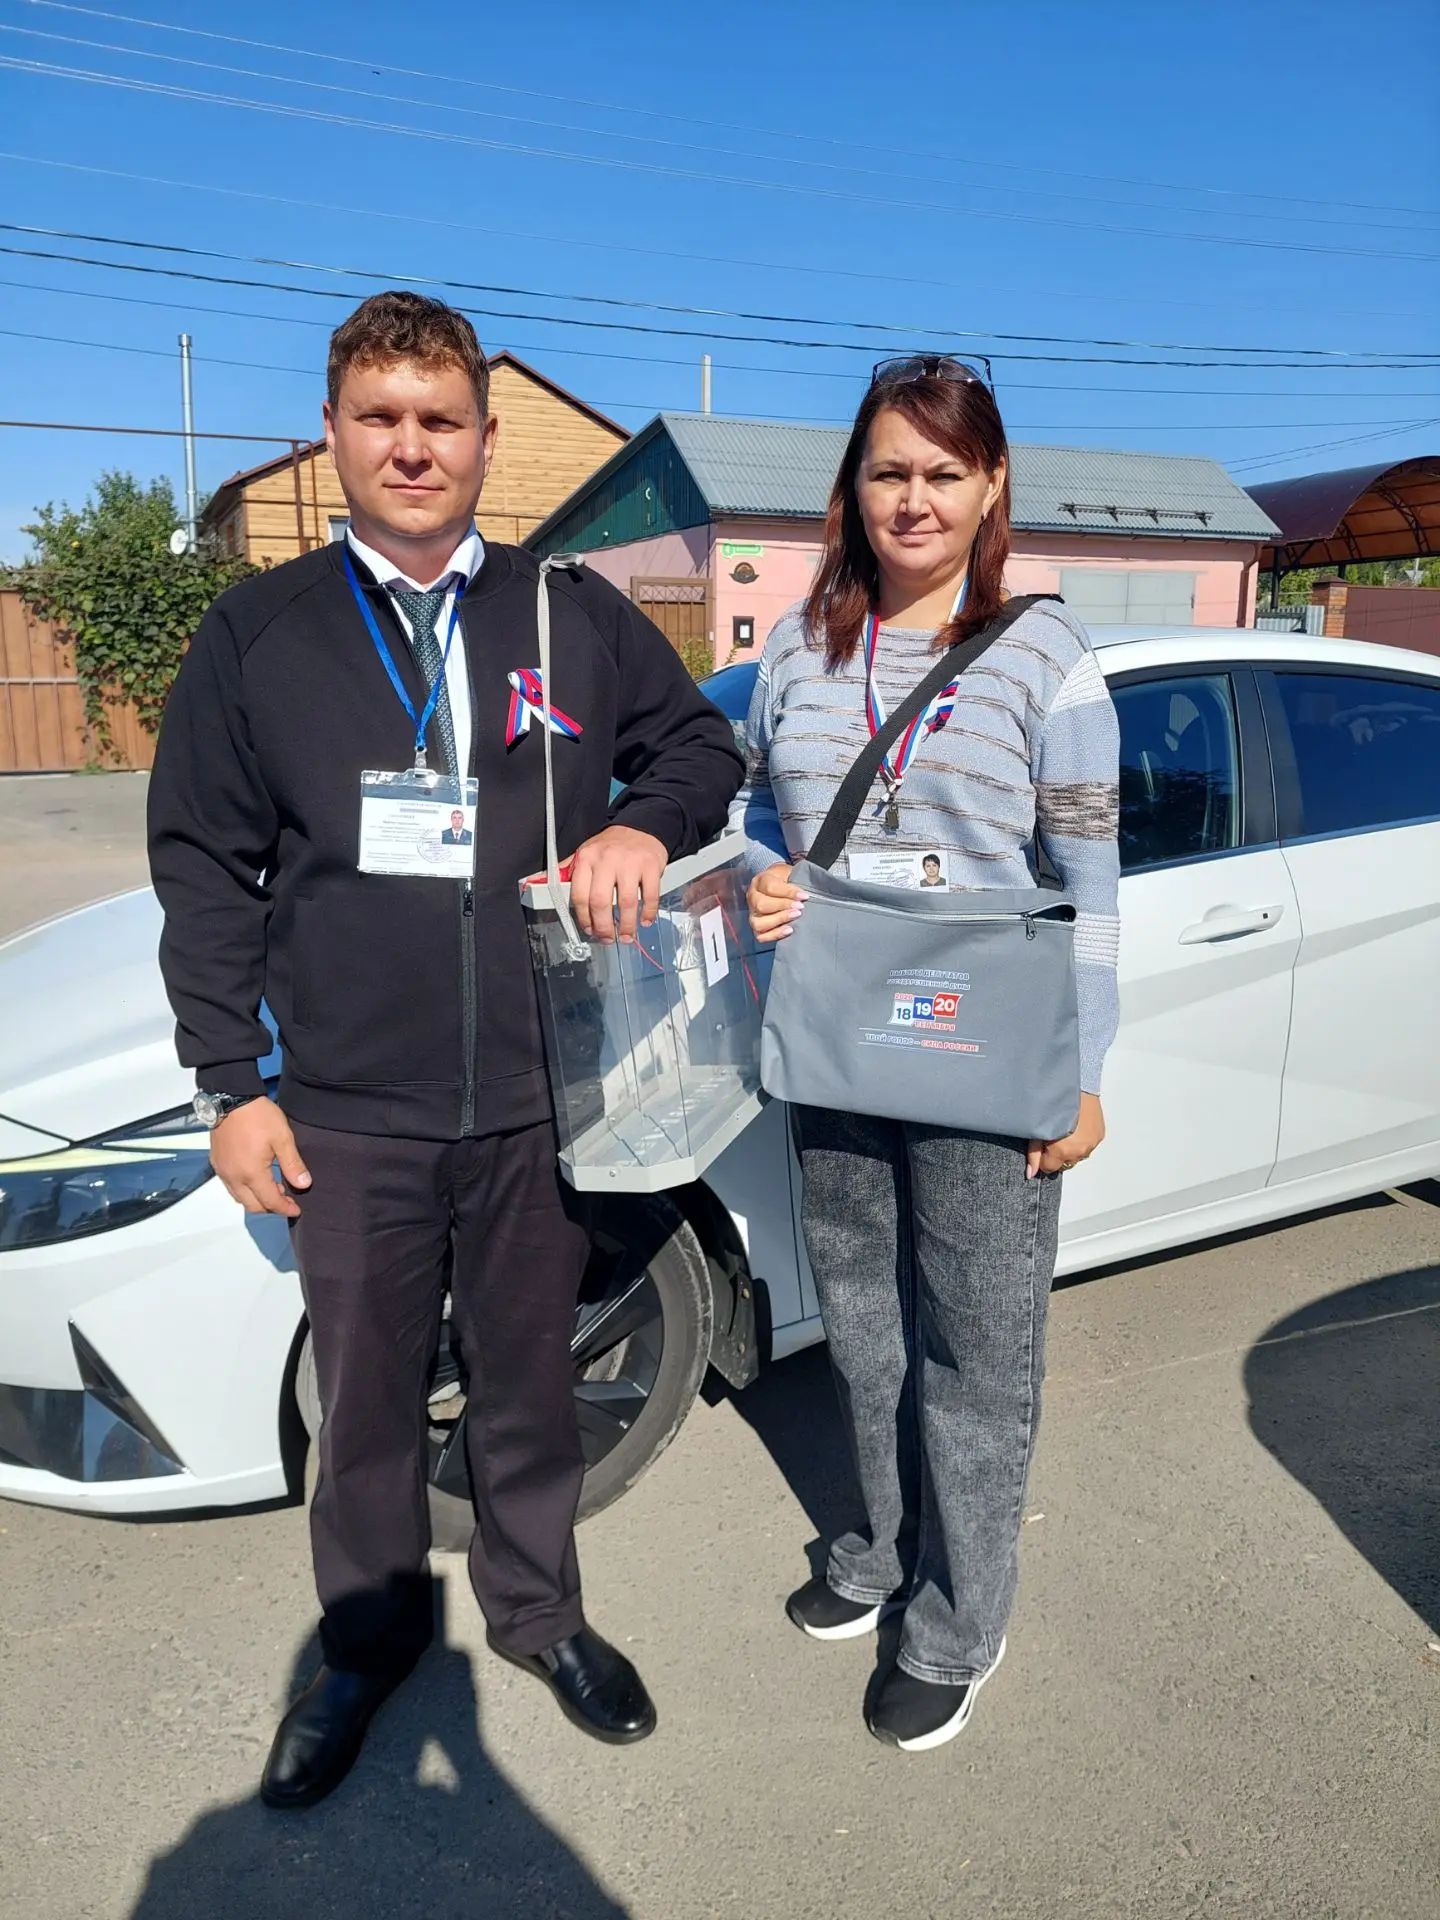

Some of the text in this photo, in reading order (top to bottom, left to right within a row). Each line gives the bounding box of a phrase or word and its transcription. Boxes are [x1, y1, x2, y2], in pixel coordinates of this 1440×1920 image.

[711, 932, 720, 962] 1
[896, 998, 955, 1020] 18 19 20
